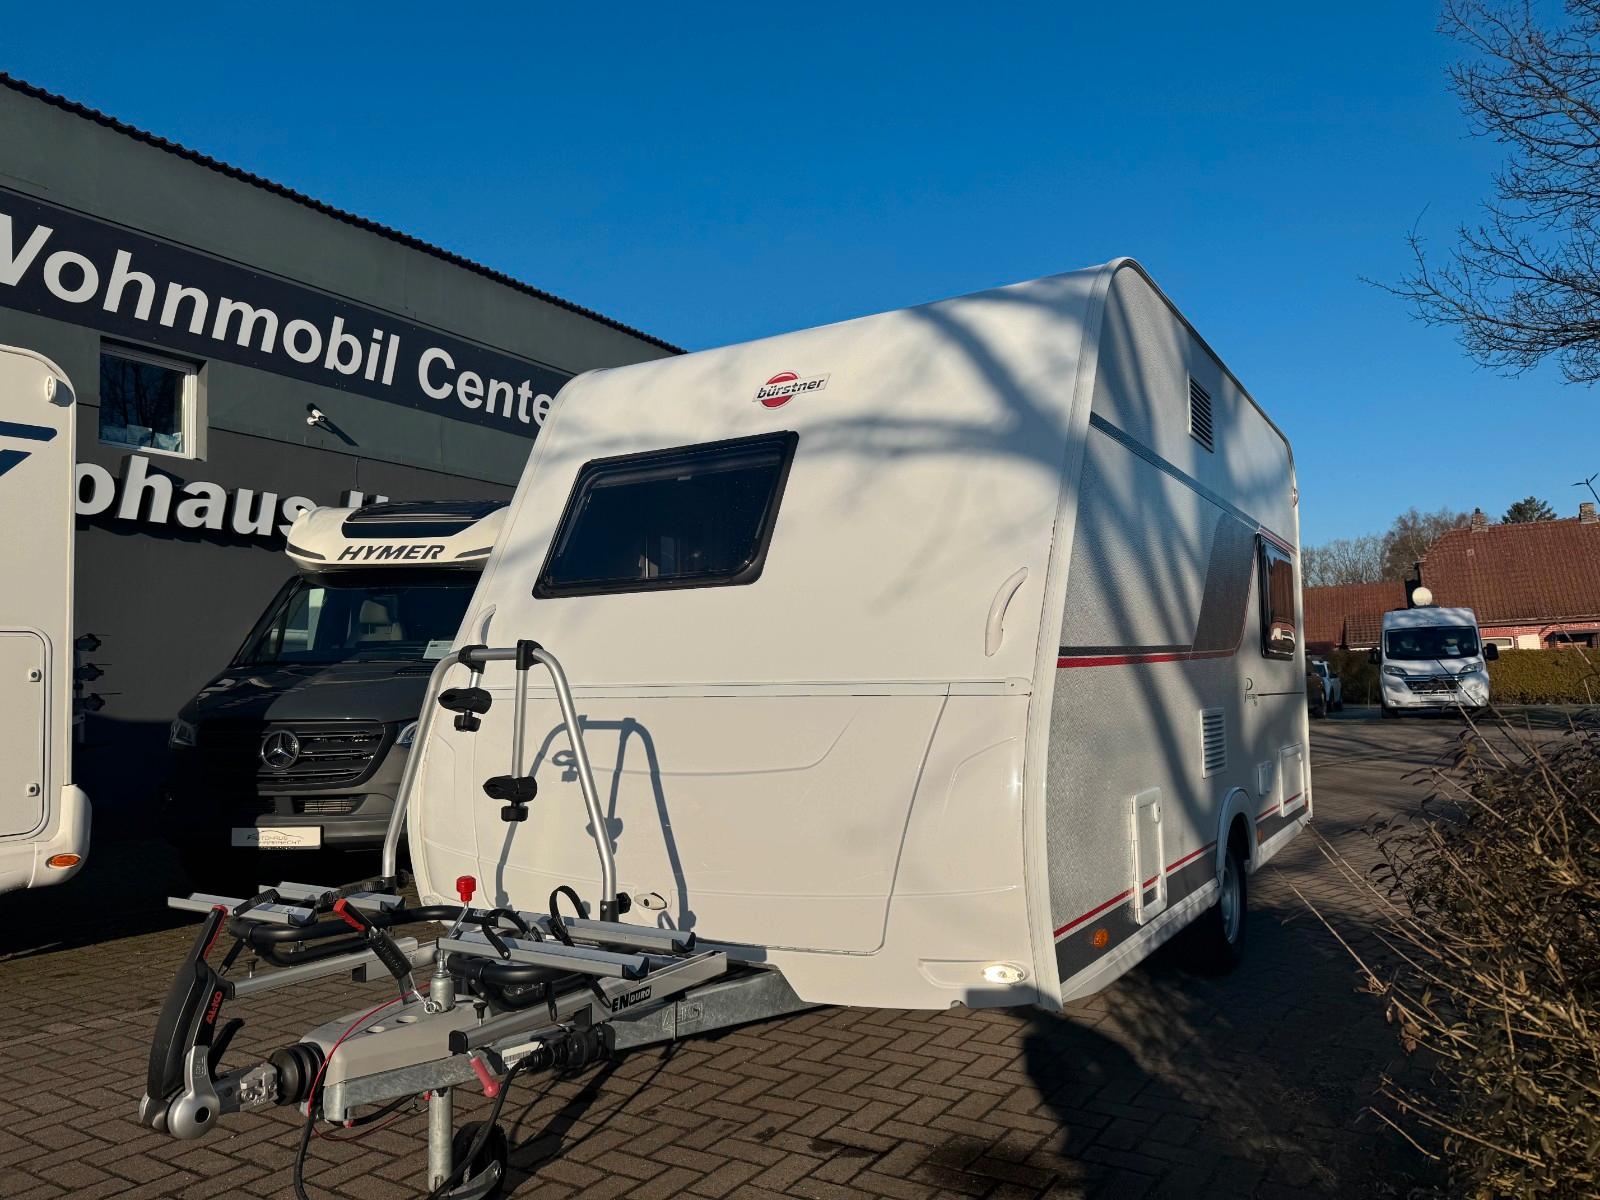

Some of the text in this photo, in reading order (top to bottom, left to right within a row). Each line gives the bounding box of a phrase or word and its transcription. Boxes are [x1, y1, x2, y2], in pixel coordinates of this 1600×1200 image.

[757, 379, 824, 399] bürstner
[338, 545, 446, 561] HYMER
[206, 991, 223, 1024] AL-KO
